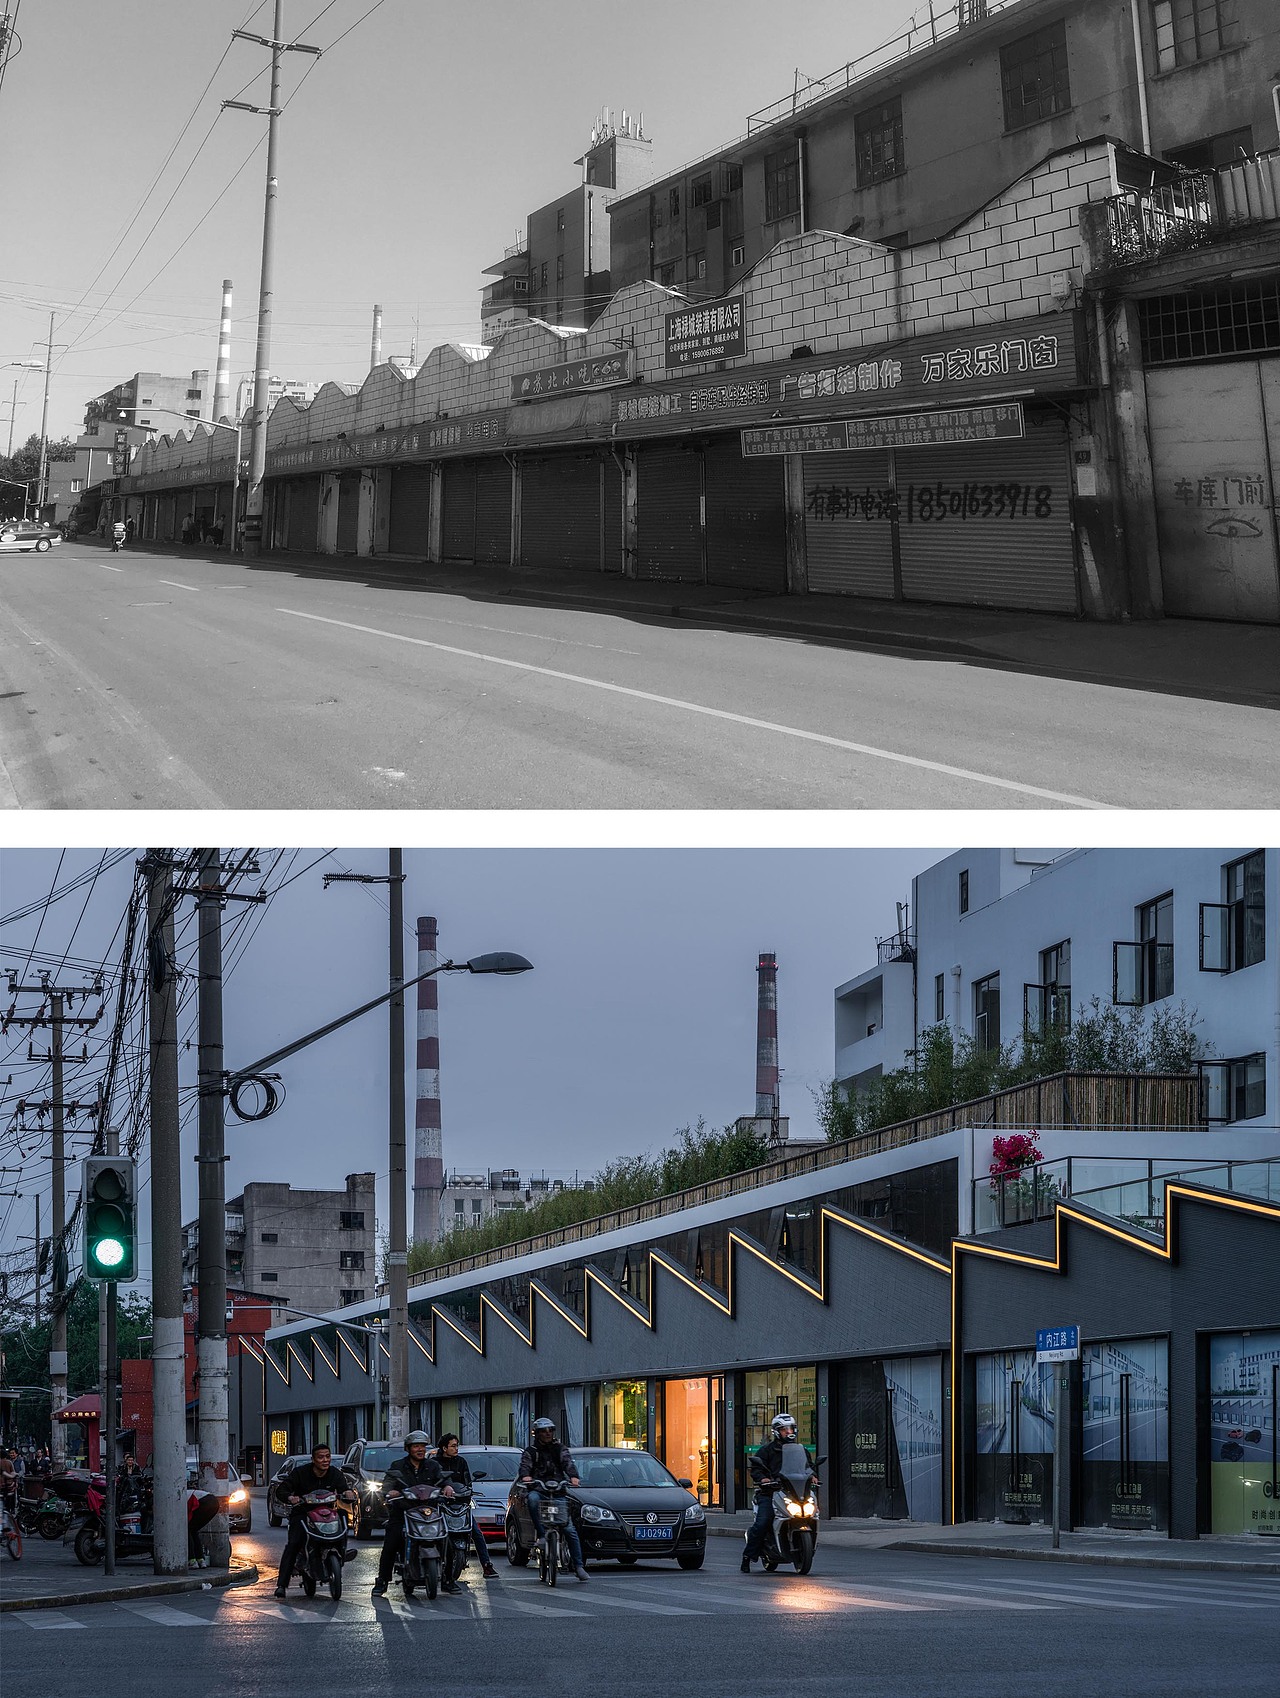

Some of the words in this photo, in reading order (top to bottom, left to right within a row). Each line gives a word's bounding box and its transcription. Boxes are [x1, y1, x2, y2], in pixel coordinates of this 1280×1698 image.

[780, 358, 904, 402] 广告灯箱制作
[920, 335, 1059, 384] 万家乐门窗
[870, 420, 898, 433] 不锈钢
[899, 416, 928, 430] 铝合金
[929, 412, 969, 428] 塑钢门窗
[996, 406, 1019, 422] 移门
[765, 430, 781, 442] 广告
[783, 428, 800, 441] 灯箱
[803, 425, 829, 438] 发光字
[886, 431, 933, 445] 不锈钢扶手
[907, 481, 1053, 523] 18501633918
[1174, 474, 1265, 507] 车库门前
[1046, 1331, 1068, 1348] 内江路
